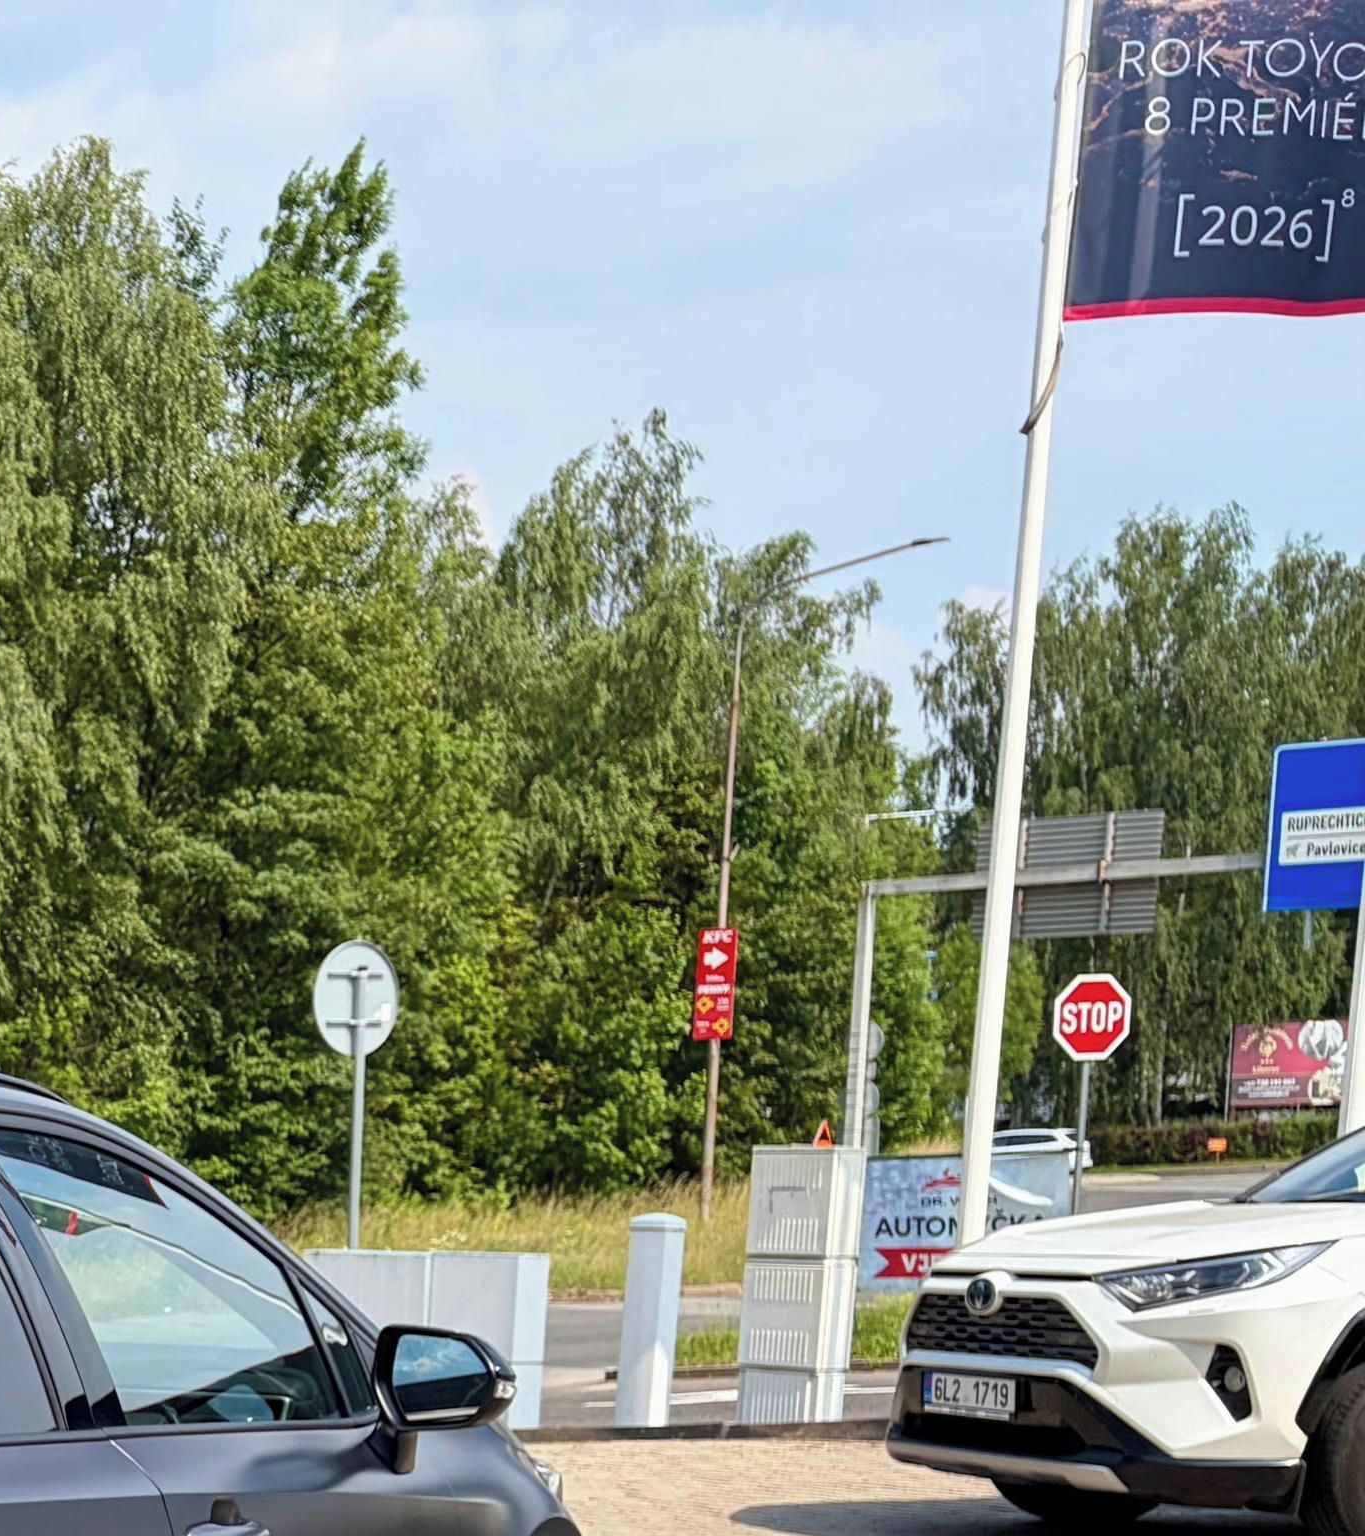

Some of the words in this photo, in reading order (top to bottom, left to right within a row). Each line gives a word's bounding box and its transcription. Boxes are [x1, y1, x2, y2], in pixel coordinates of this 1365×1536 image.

[1119, 37, 1222, 80] ROK
[1144, 96, 1171, 136] 8
[1190, 92, 1365, 140] PREMIÉ
[1287, 812, 1365, 832] RUPRECHTIC
[702, 929, 734, 944] KFC
[1061, 1000, 1123, 1035] STOP
[934, 1376, 961, 1402] 6L2
[973, 1380, 1009, 1408] 1719
